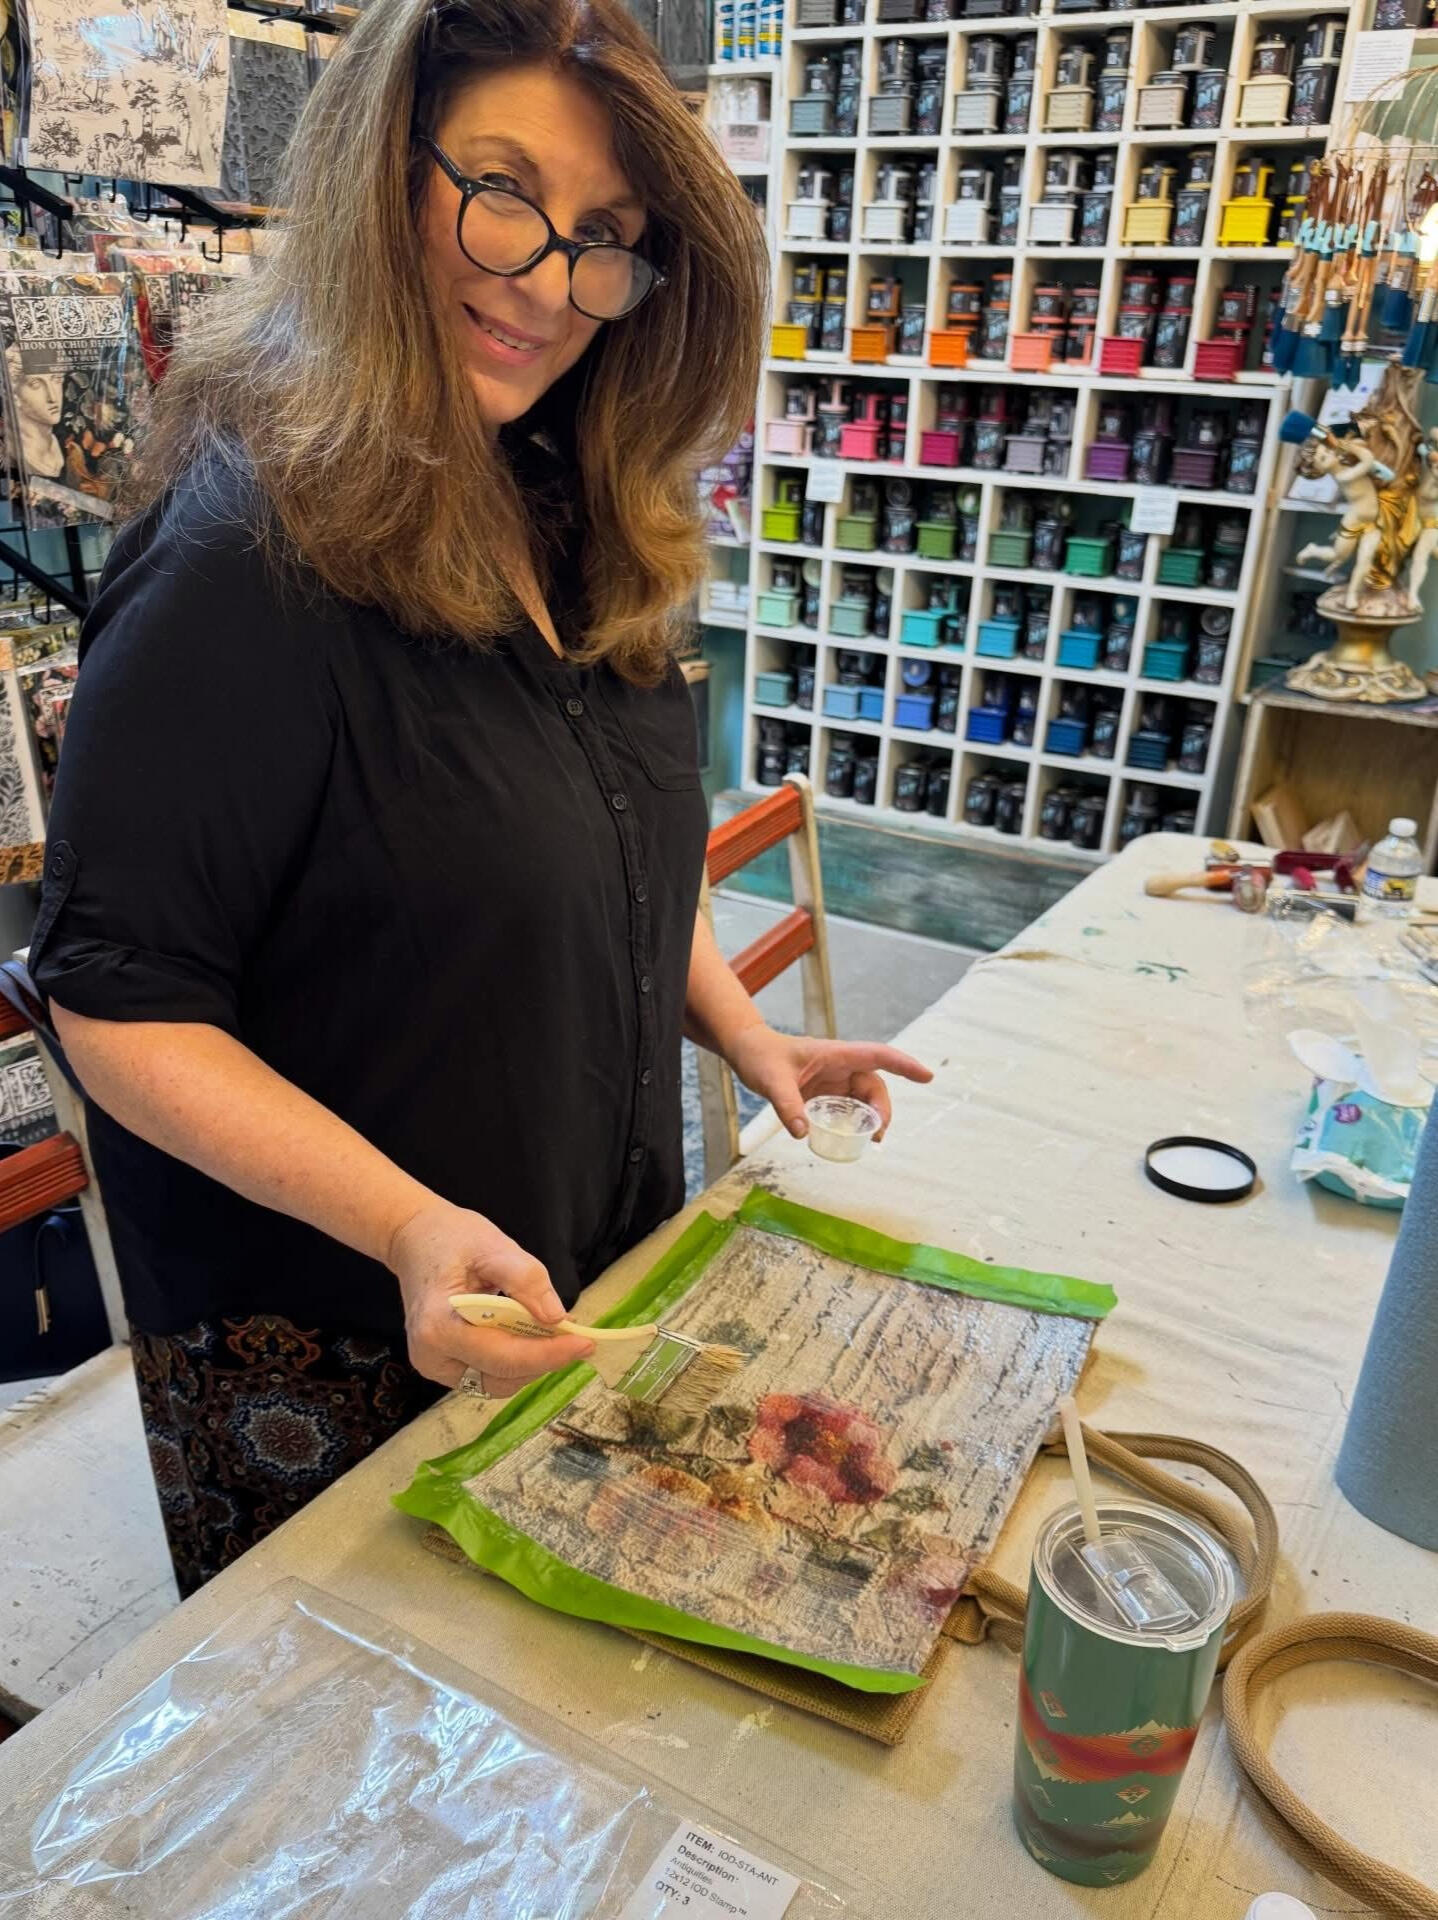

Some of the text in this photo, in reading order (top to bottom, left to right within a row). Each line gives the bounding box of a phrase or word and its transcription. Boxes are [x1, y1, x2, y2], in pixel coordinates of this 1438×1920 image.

[20, 342, 46, 351] IRON
[49, 340, 88, 350] ORCHID
[686, 1832, 779, 1886] ITEM: IOD-STA-ANT
[655, 1880, 690, 1906] QTY: 3
[690, 1883, 709, 1897] IOD
